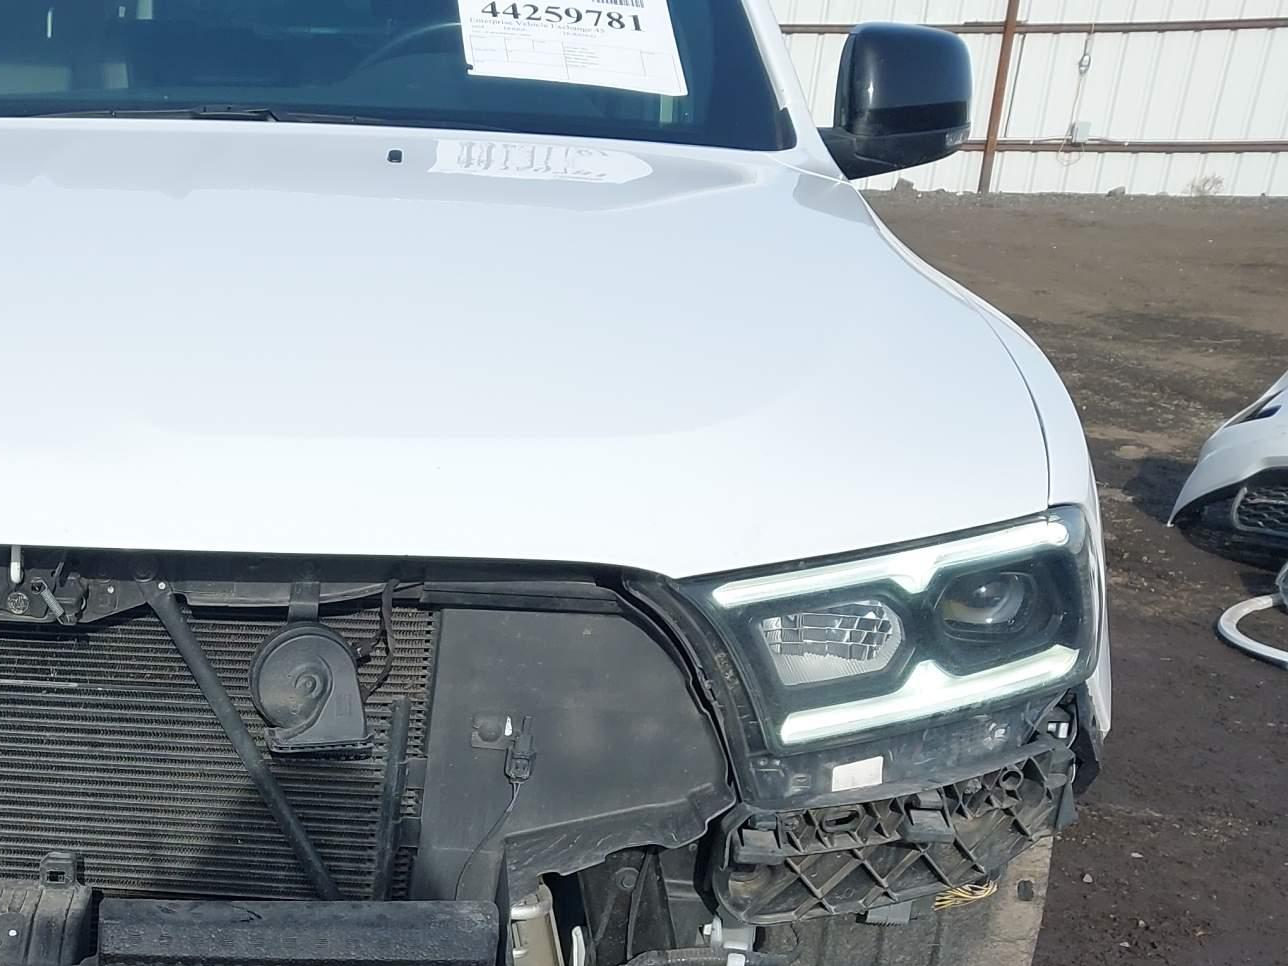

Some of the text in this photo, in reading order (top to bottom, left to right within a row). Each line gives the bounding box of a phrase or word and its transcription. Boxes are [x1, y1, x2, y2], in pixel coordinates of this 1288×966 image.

[481, 1, 645, 32] 44259781
[515, 20, 549, 28] Vehicle
[550, 23, 592, 33] Exchange
